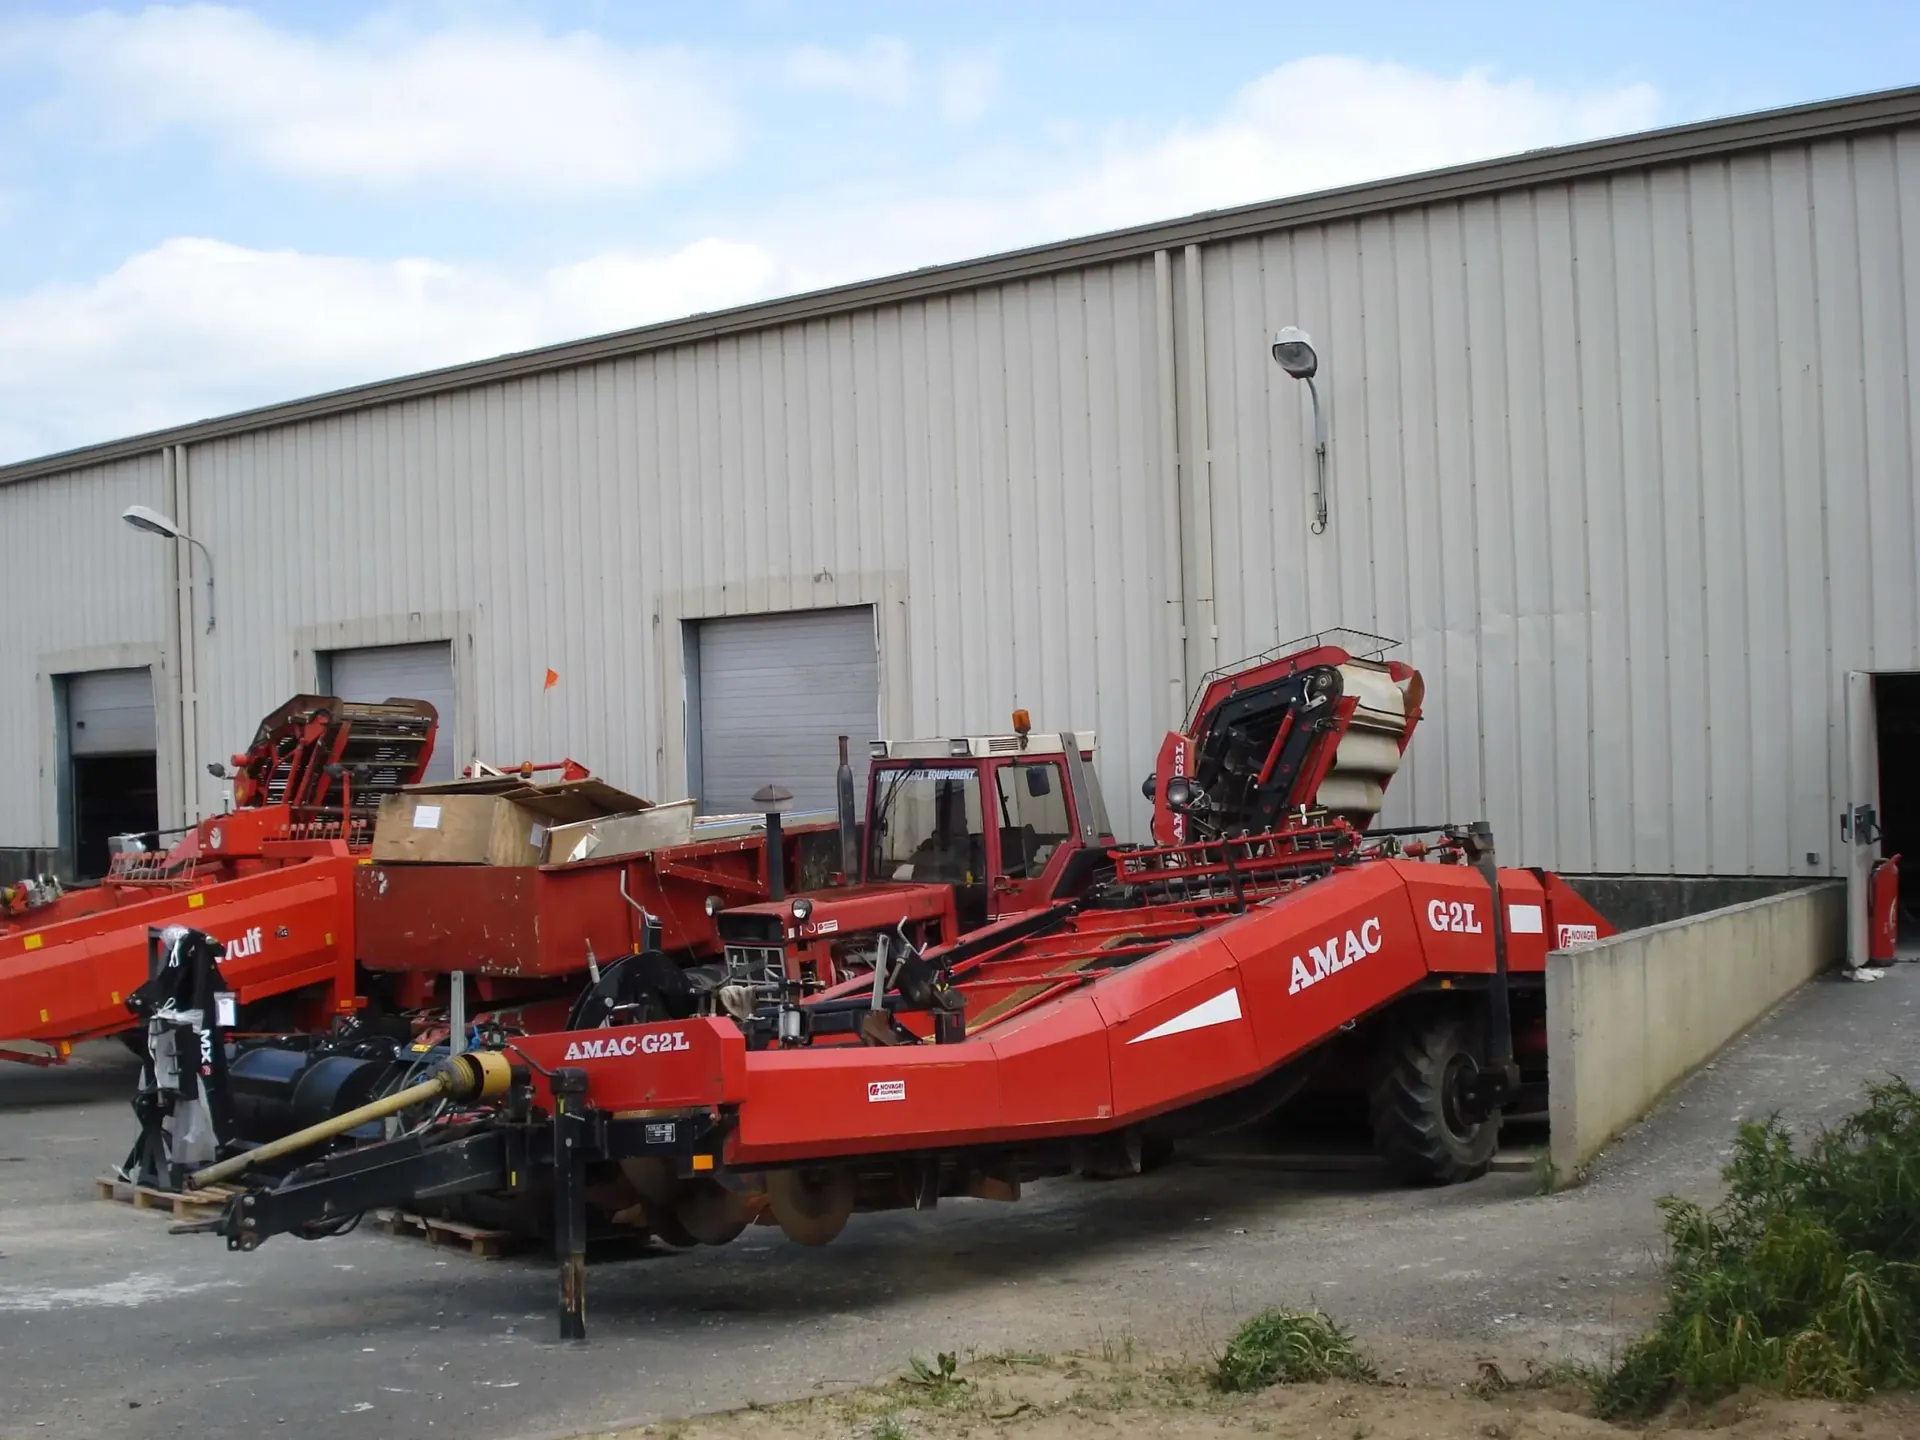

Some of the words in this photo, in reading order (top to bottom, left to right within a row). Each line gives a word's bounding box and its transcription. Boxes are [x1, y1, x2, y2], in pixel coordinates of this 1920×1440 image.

[927, 769, 976, 781] EQUIPEMENT
[1427, 899, 1482, 934] G2L
[1288, 916, 1382, 996] AMAC
[200, 1028, 212, 1064] MX
